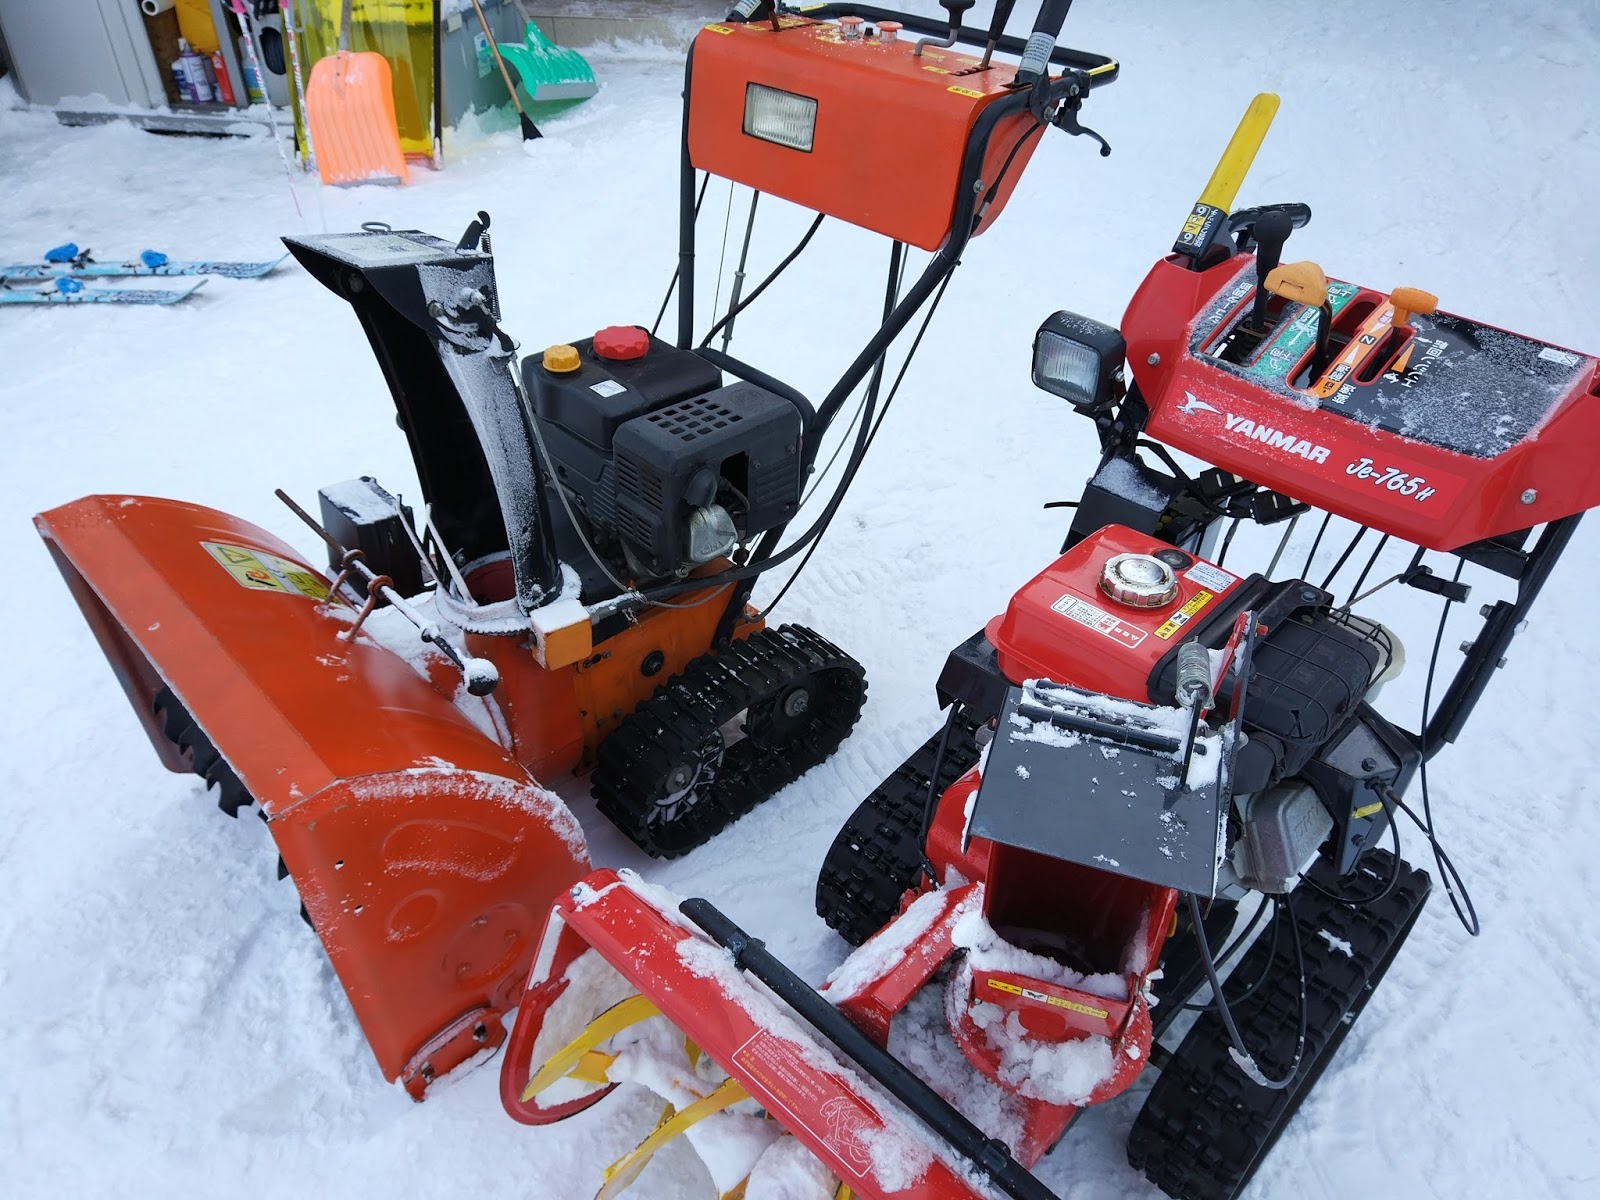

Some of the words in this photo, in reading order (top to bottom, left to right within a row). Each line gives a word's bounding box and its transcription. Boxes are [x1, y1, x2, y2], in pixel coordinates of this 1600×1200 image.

[1361, 335, 1375, 343] N
[1401, 339, 1449, 388] エンジン回転
[1332, 383, 1357, 404] 変速
[1224, 412, 1331, 465] YANMAR
